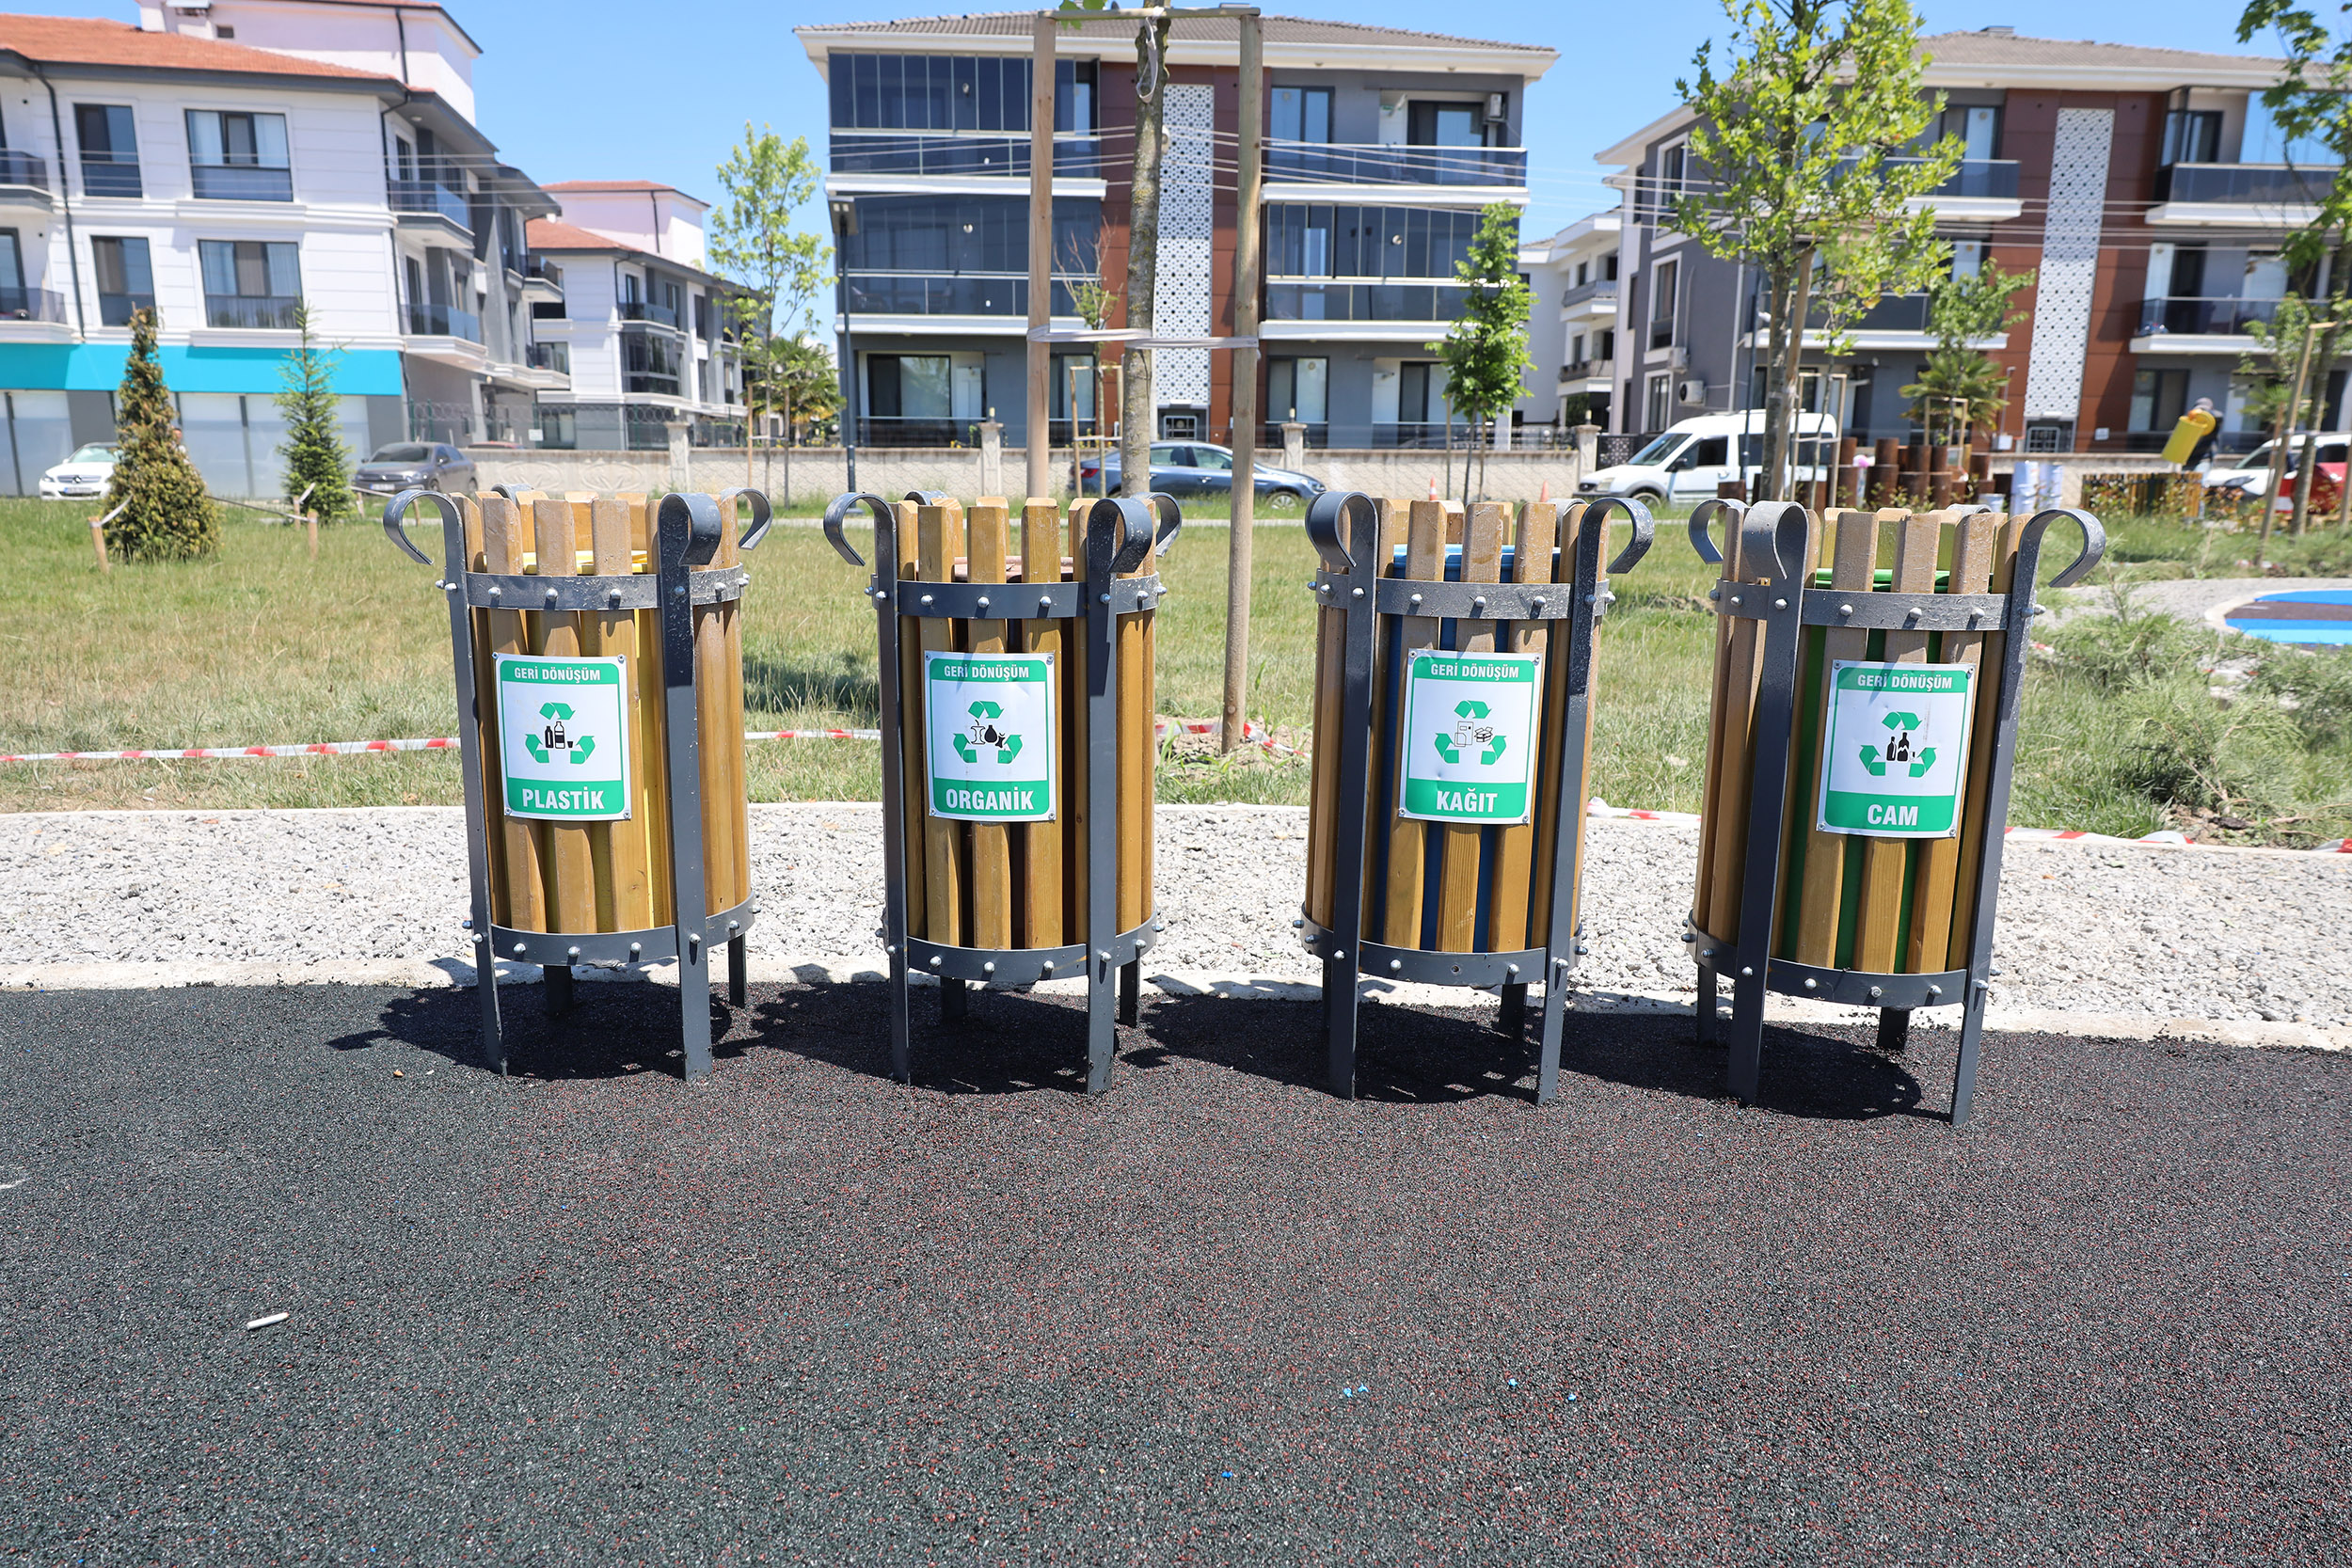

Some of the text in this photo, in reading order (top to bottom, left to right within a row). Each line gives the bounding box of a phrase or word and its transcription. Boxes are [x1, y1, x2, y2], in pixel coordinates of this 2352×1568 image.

[514, 666, 601, 684] GERİ DÖNÜŞÜM
[944, 663, 1029, 681] GERİ DÖNÜŞÜM
[1431, 662, 1519, 681] GERİ DÖNÜŞÜM
[1857, 673, 1953, 691] GERİ DÖNÜŞÜM
[522, 786, 605, 810] PLASTİK
[946, 786, 1034, 811] ORGANİK
[1436, 787, 1498, 813] KAĞIT
[1867, 804, 1919, 826] CAM
